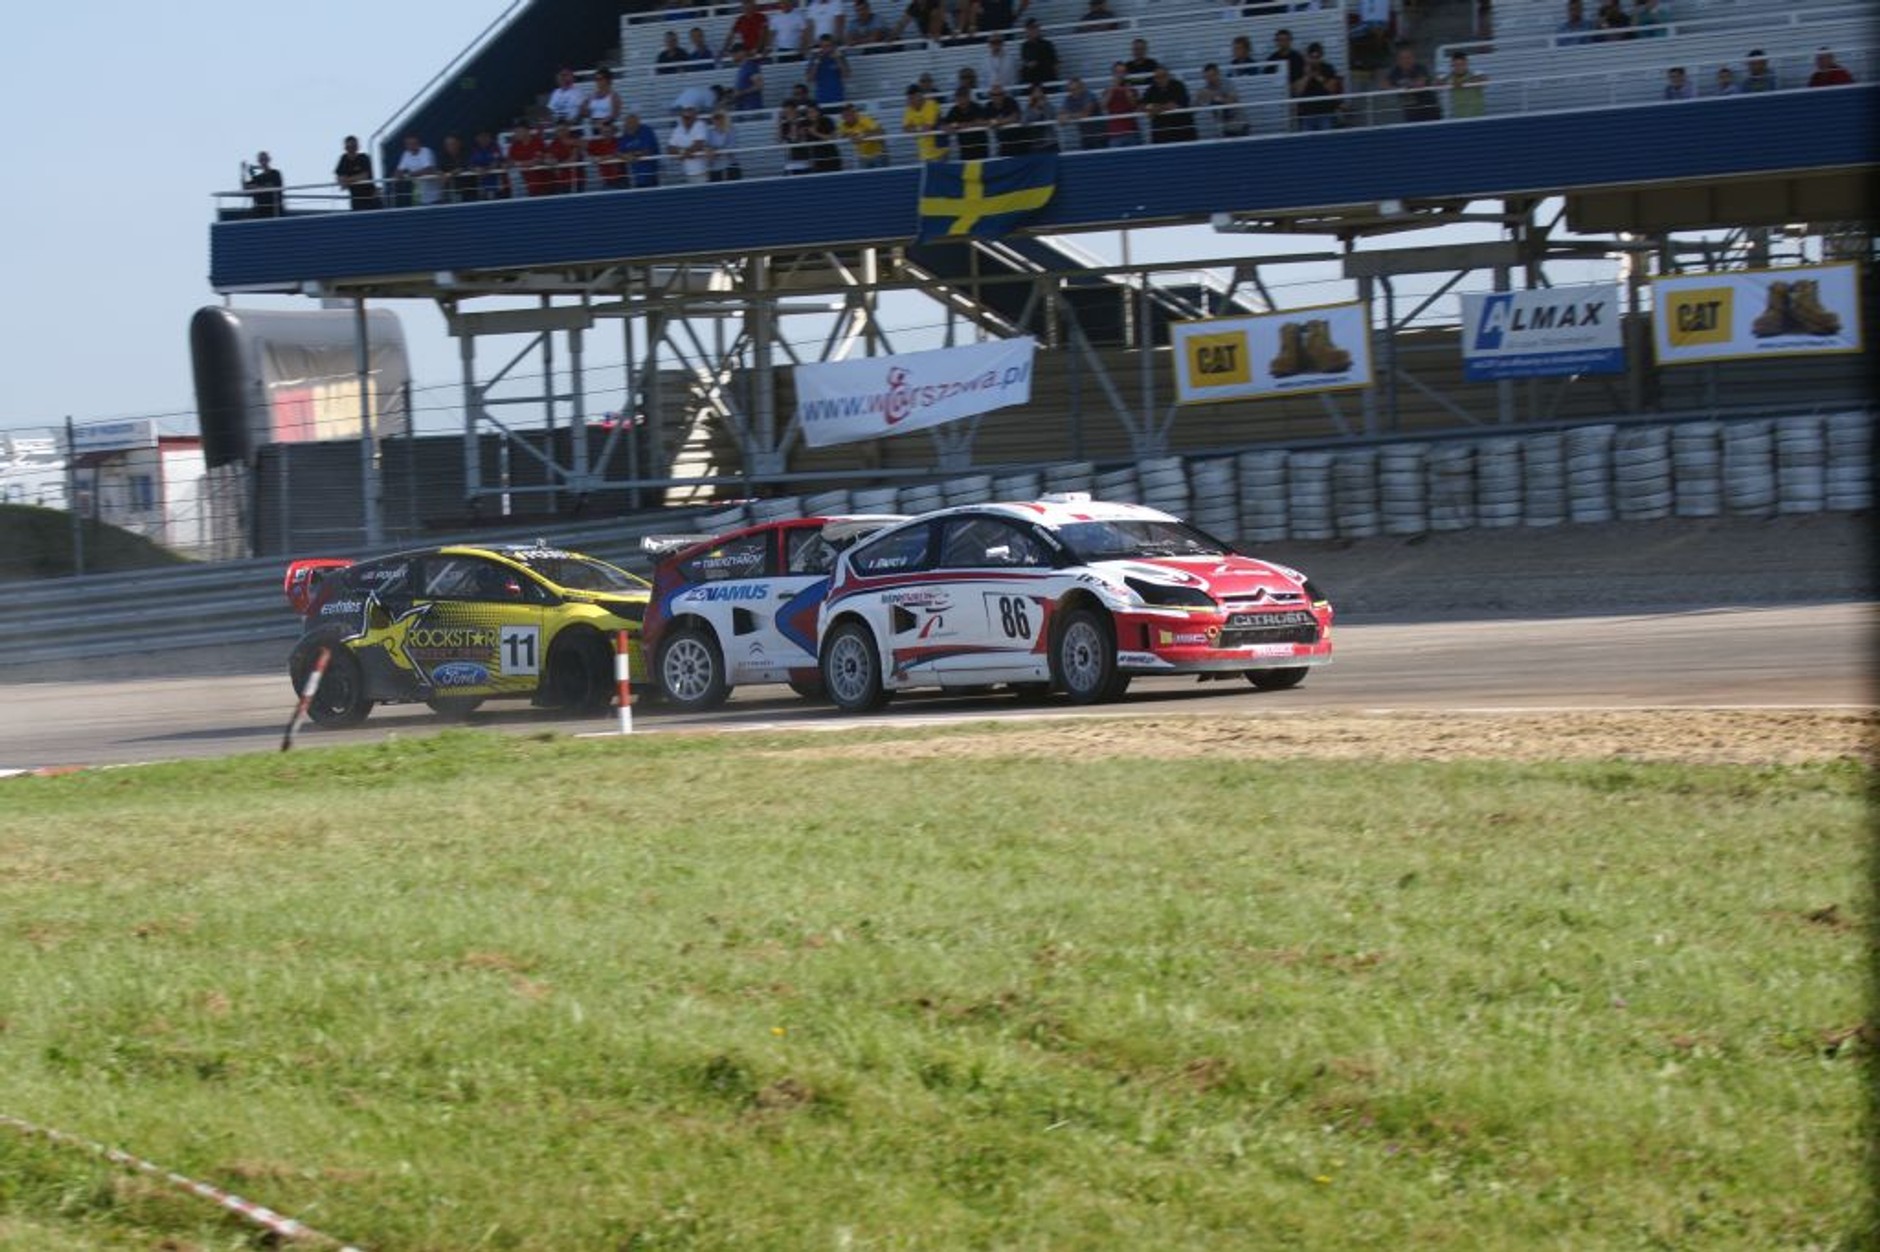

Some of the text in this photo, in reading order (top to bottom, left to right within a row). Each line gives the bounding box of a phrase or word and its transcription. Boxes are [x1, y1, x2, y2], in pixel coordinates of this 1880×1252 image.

[1483, 300, 1605, 334] ALMAX
[1678, 300, 1723, 332] CAT
[1198, 344, 1239, 374] CAT
[999, 596, 1032, 640] 86
[503, 633, 535, 667] 11
[441, 668, 479, 684] Ford
